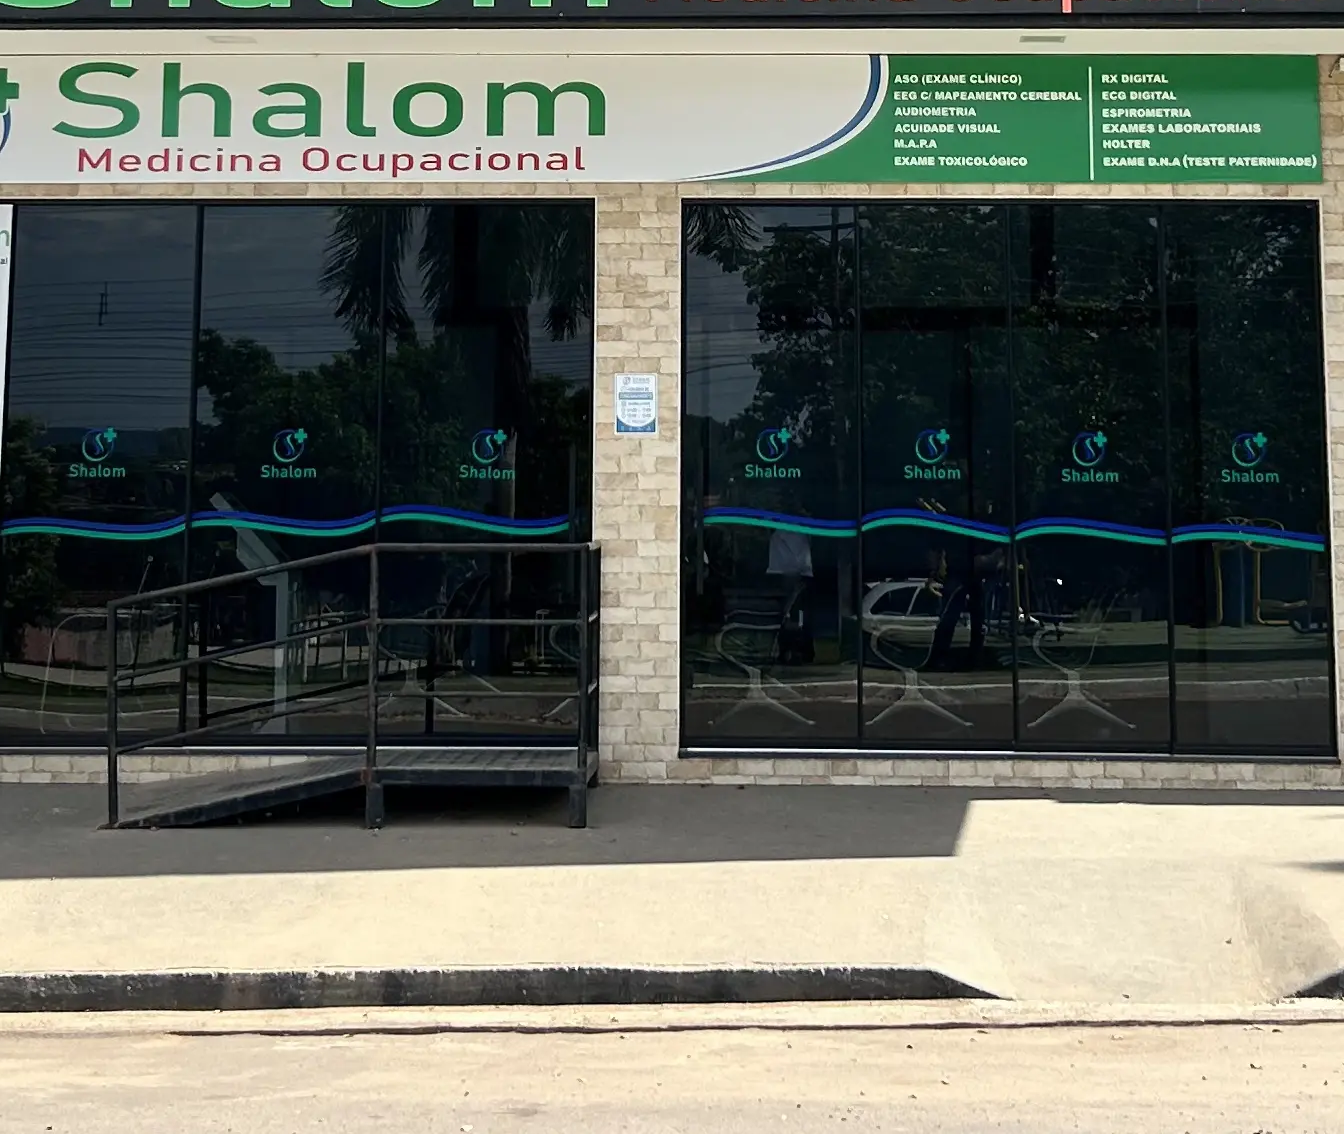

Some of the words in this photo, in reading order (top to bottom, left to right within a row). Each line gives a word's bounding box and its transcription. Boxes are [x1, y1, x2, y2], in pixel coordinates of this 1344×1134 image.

[894, 74, 919, 84] ASO
[921, 74, 966, 86] (EXAME
[969, 73, 1023, 86] CLÍNICO)
[1101, 74, 1118, 83] RX
[1121, 74, 1169, 84] DIGITAL
[52, 61, 606, 138] Shalom
[894, 91, 918, 101] EEG
[920, 91, 932, 101] C/
[934, 91, 1018, 101] MAPEAMENTO
[1020, 91, 1082, 101] CEREBRAL
[1102, 91, 1127, 101] ECG
[1130, 91, 1177, 101] DIGITAL
[894, 107, 976, 117] AUDIOMETRIA
[1102, 108, 1192, 118] ESPIROMETRIA
[894, 124, 954, 133] ACUIDADE
[957, 124, 1001, 133] VISUAL
[1102, 123, 1155, 133] EXAMES
[1158, 123, 1261, 133] LABORATORIAIS
[1102, 139, 1150, 149] HOLTER
[78, 147, 282, 173] Medicina
[302, 146, 586, 177] Ocupacional
[894, 156, 935, 166] EXAME
[938, 154, 1028, 166] TOXICOLÓGICO
[1102, 156, 1145, 167] EXAME
[1182, 154, 1226, 168] (TESTE
[1228, 154, 1318, 168] PATERNIDADE)
[68, 462, 126, 478] Shalom
[260, 464, 317, 479] Shalom
[459, 465, 516, 480] Shalom
[744, 464, 801, 479] Shalom
[904, 465, 961, 480] Shalom
[1061, 469, 1119, 483] Shalom
[1221, 469, 1279, 484] Shalom
